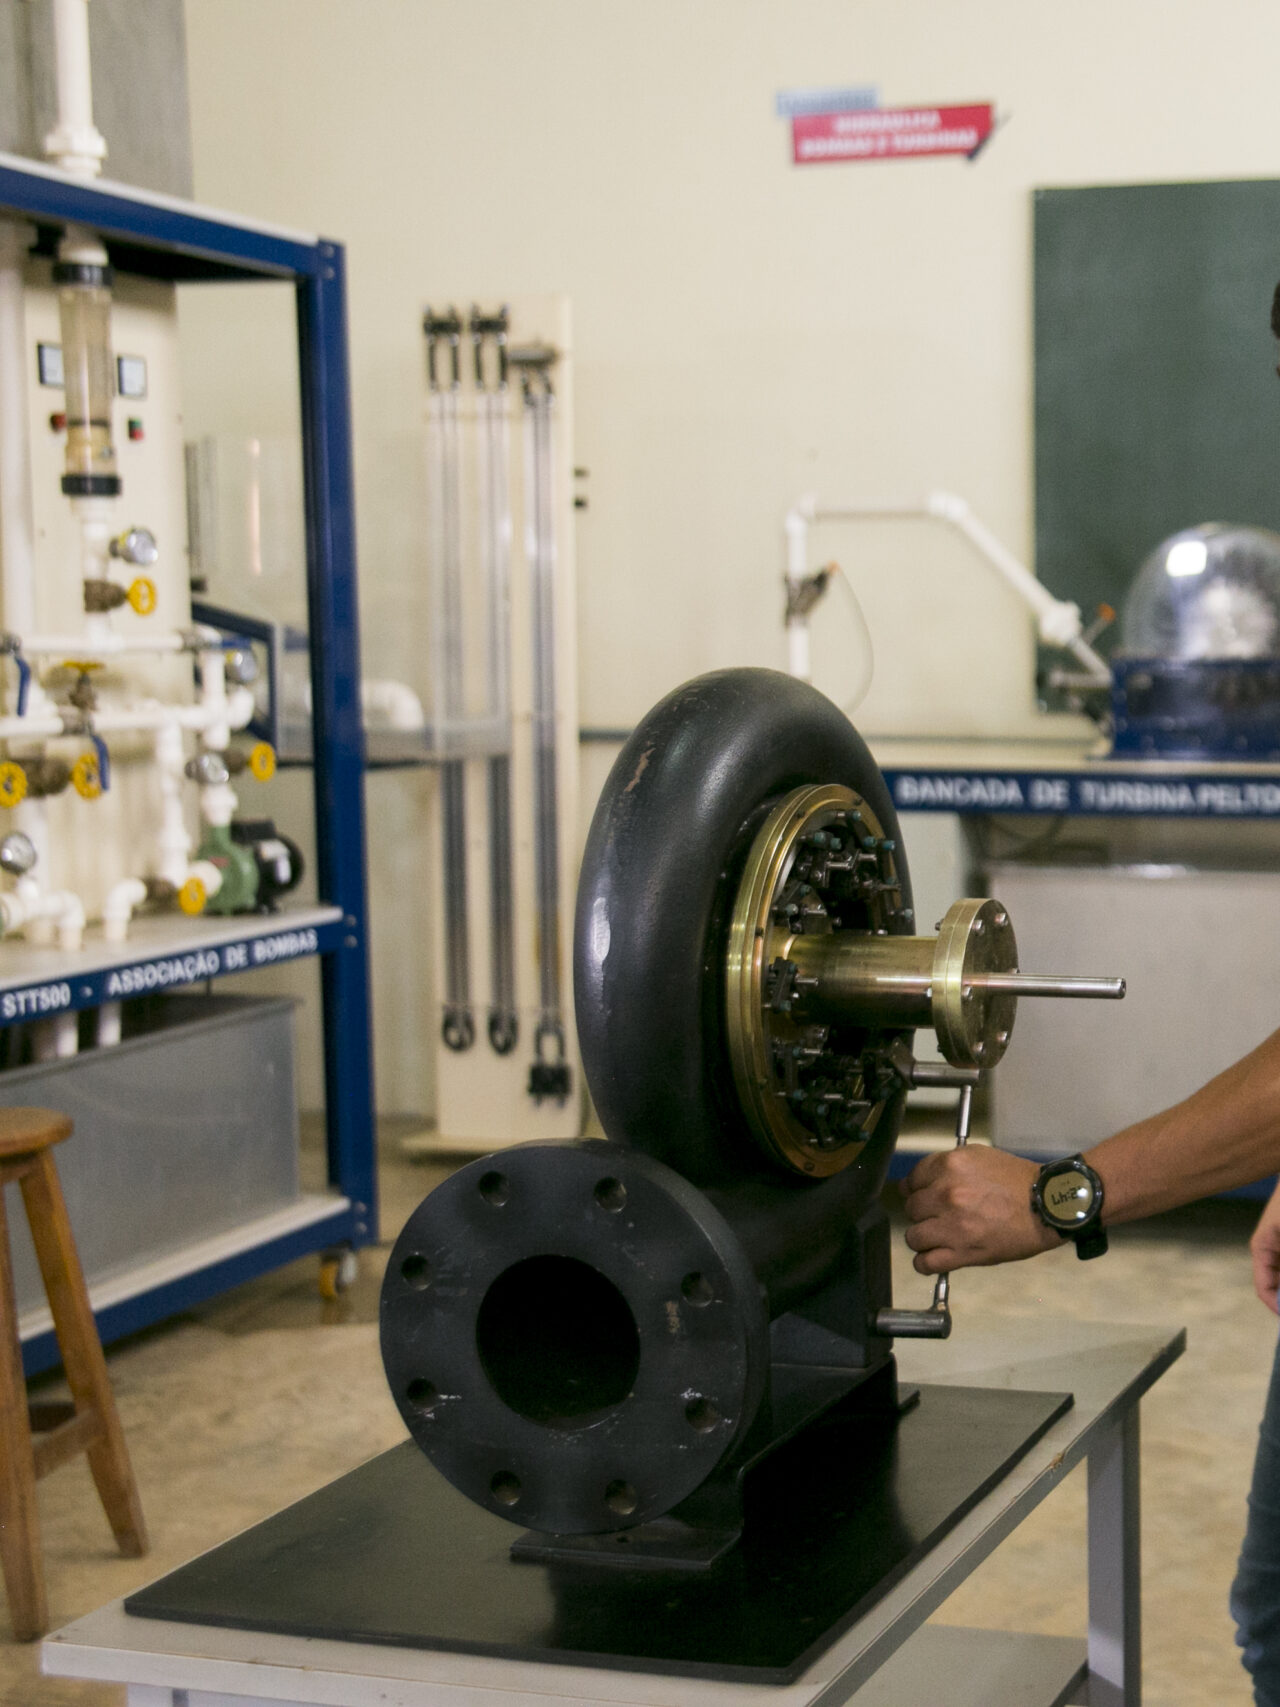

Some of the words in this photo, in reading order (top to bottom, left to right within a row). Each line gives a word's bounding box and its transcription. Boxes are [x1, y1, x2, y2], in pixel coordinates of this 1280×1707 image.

[896, 775, 1023, 806] BANCADA
[1029, 778, 1069, 807] DE
[1080, 780, 1196, 811] TURBINA
[2, 981, 71, 1019] STT500
[109, 948, 221, 996] ASSOCIAÇÃO
[225, 943, 249, 970] DE
[254, 928, 319, 963] BOMBAS
